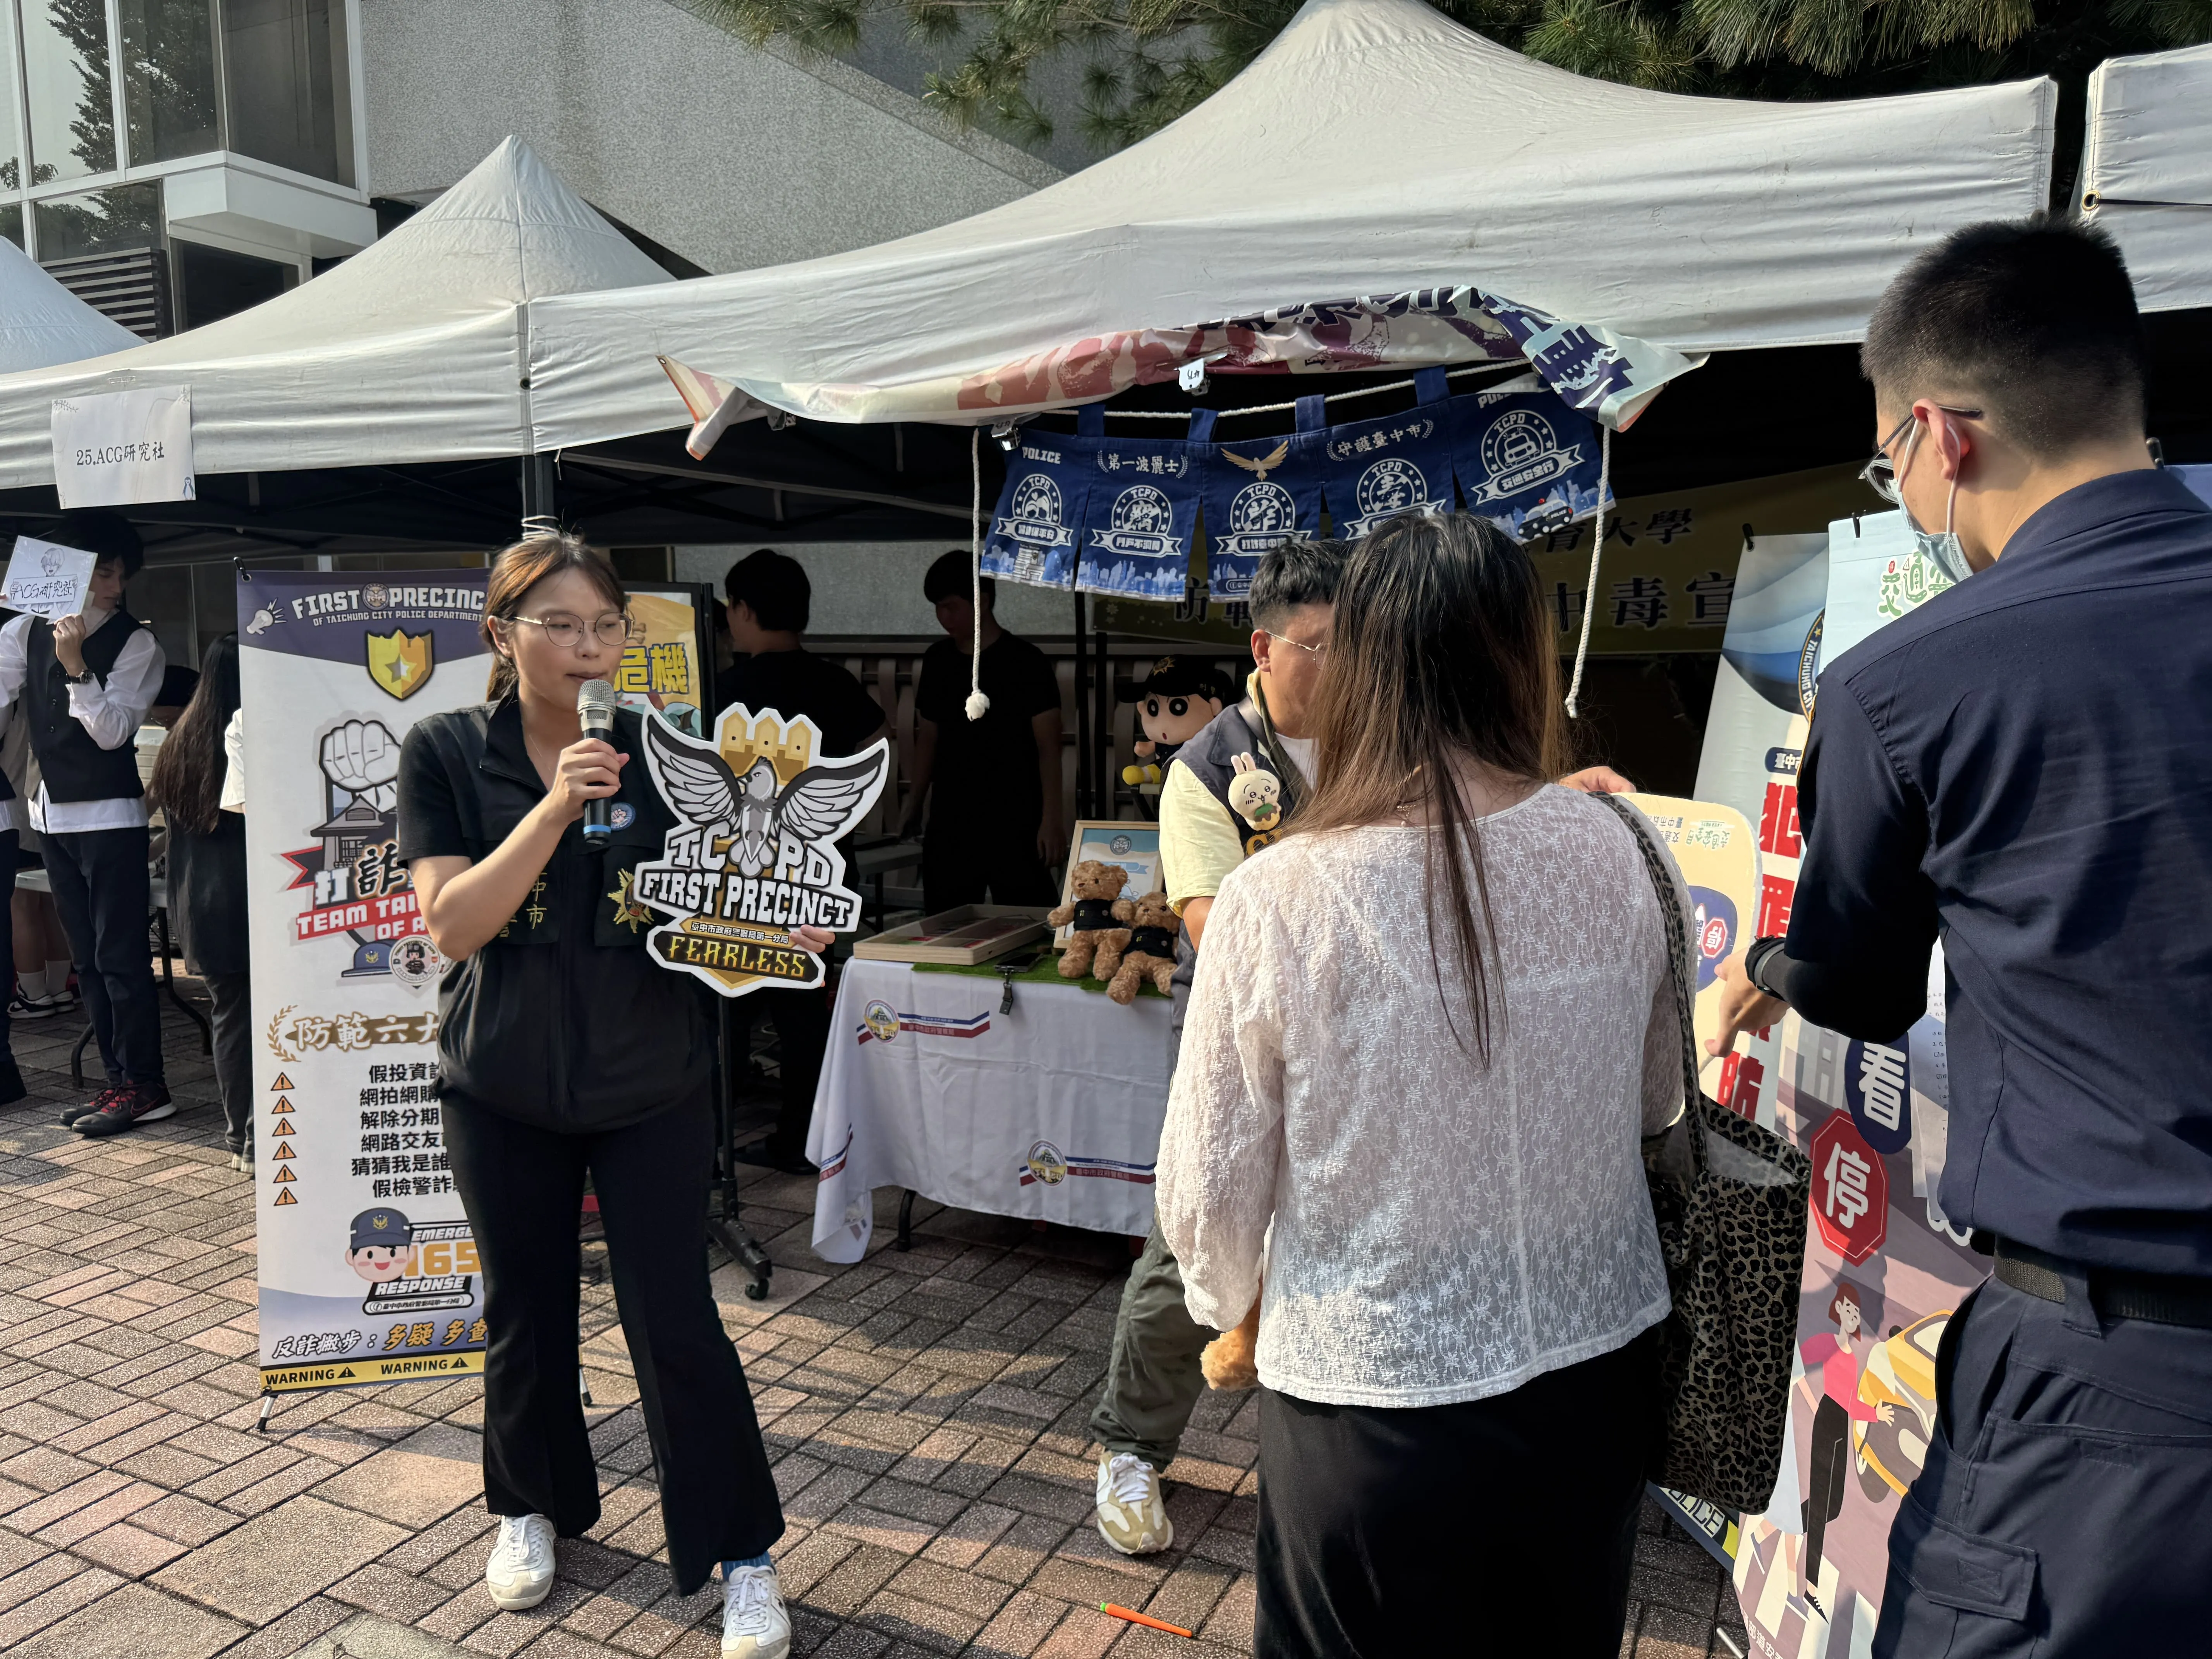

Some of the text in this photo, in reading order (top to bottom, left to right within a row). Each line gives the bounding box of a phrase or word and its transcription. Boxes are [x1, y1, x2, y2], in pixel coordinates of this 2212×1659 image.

[1494, 413, 1525, 433] TCPD
[1338, 424, 1422, 456] 守護臺中市
[76, 441, 165, 466] 25.ACG研究社
[1022, 447, 1061, 464] POLICE
[1108, 453, 1179, 474] 第一波麗士
[1371, 462, 1402, 476] TCPD
[1501, 460, 1554, 490] 交通安全行
[1029, 477, 1050, 489] TCPD
[1130, 488, 1158, 500] TCPD
[1247, 485, 1276, 498] TCPD
[1551, 509, 1566, 519] POLICE
[13, 580, 73, 600] ACG研究社
[292, 587, 485, 619] FIRST PRECINC
[313, 610, 483, 626] OF TAICHUNG CITY POLICE DEPARTMENT
[614, 644, 688, 694] 危機
[1802, 639, 1819, 691] TAICHUNG
[314, 842, 414, 905] 打詐
[644, 872, 850, 925] FIRST PRECINCT
[297, 904, 367, 935] TEAM
[377, 920, 405, 939] OF
[1705, 926, 1722, 949] 停
[669, 935, 805, 977] FEARLESS
[1859, 1041, 1906, 1131] 看
[361, 1108, 439, 1129] 解除分期
[361, 1130, 443, 1152] 網路交友
[351, 1153, 451, 1176] 猜猜我是誰
[372, 1175, 459, 1198] 假檢警詐
[1824, 1142, 1870, 1228] 停
[411, 1227, 473, 1242] EMERGE
[404, 1242, 482, 1277] 165
[374, 1277, 465, 1296] RESPONSE
[382, 1321, 435, 1351] 多疑
[442, 1317, 488, 1346] 多查
[266, 1359, 448, 1385] WARNING WARNING
